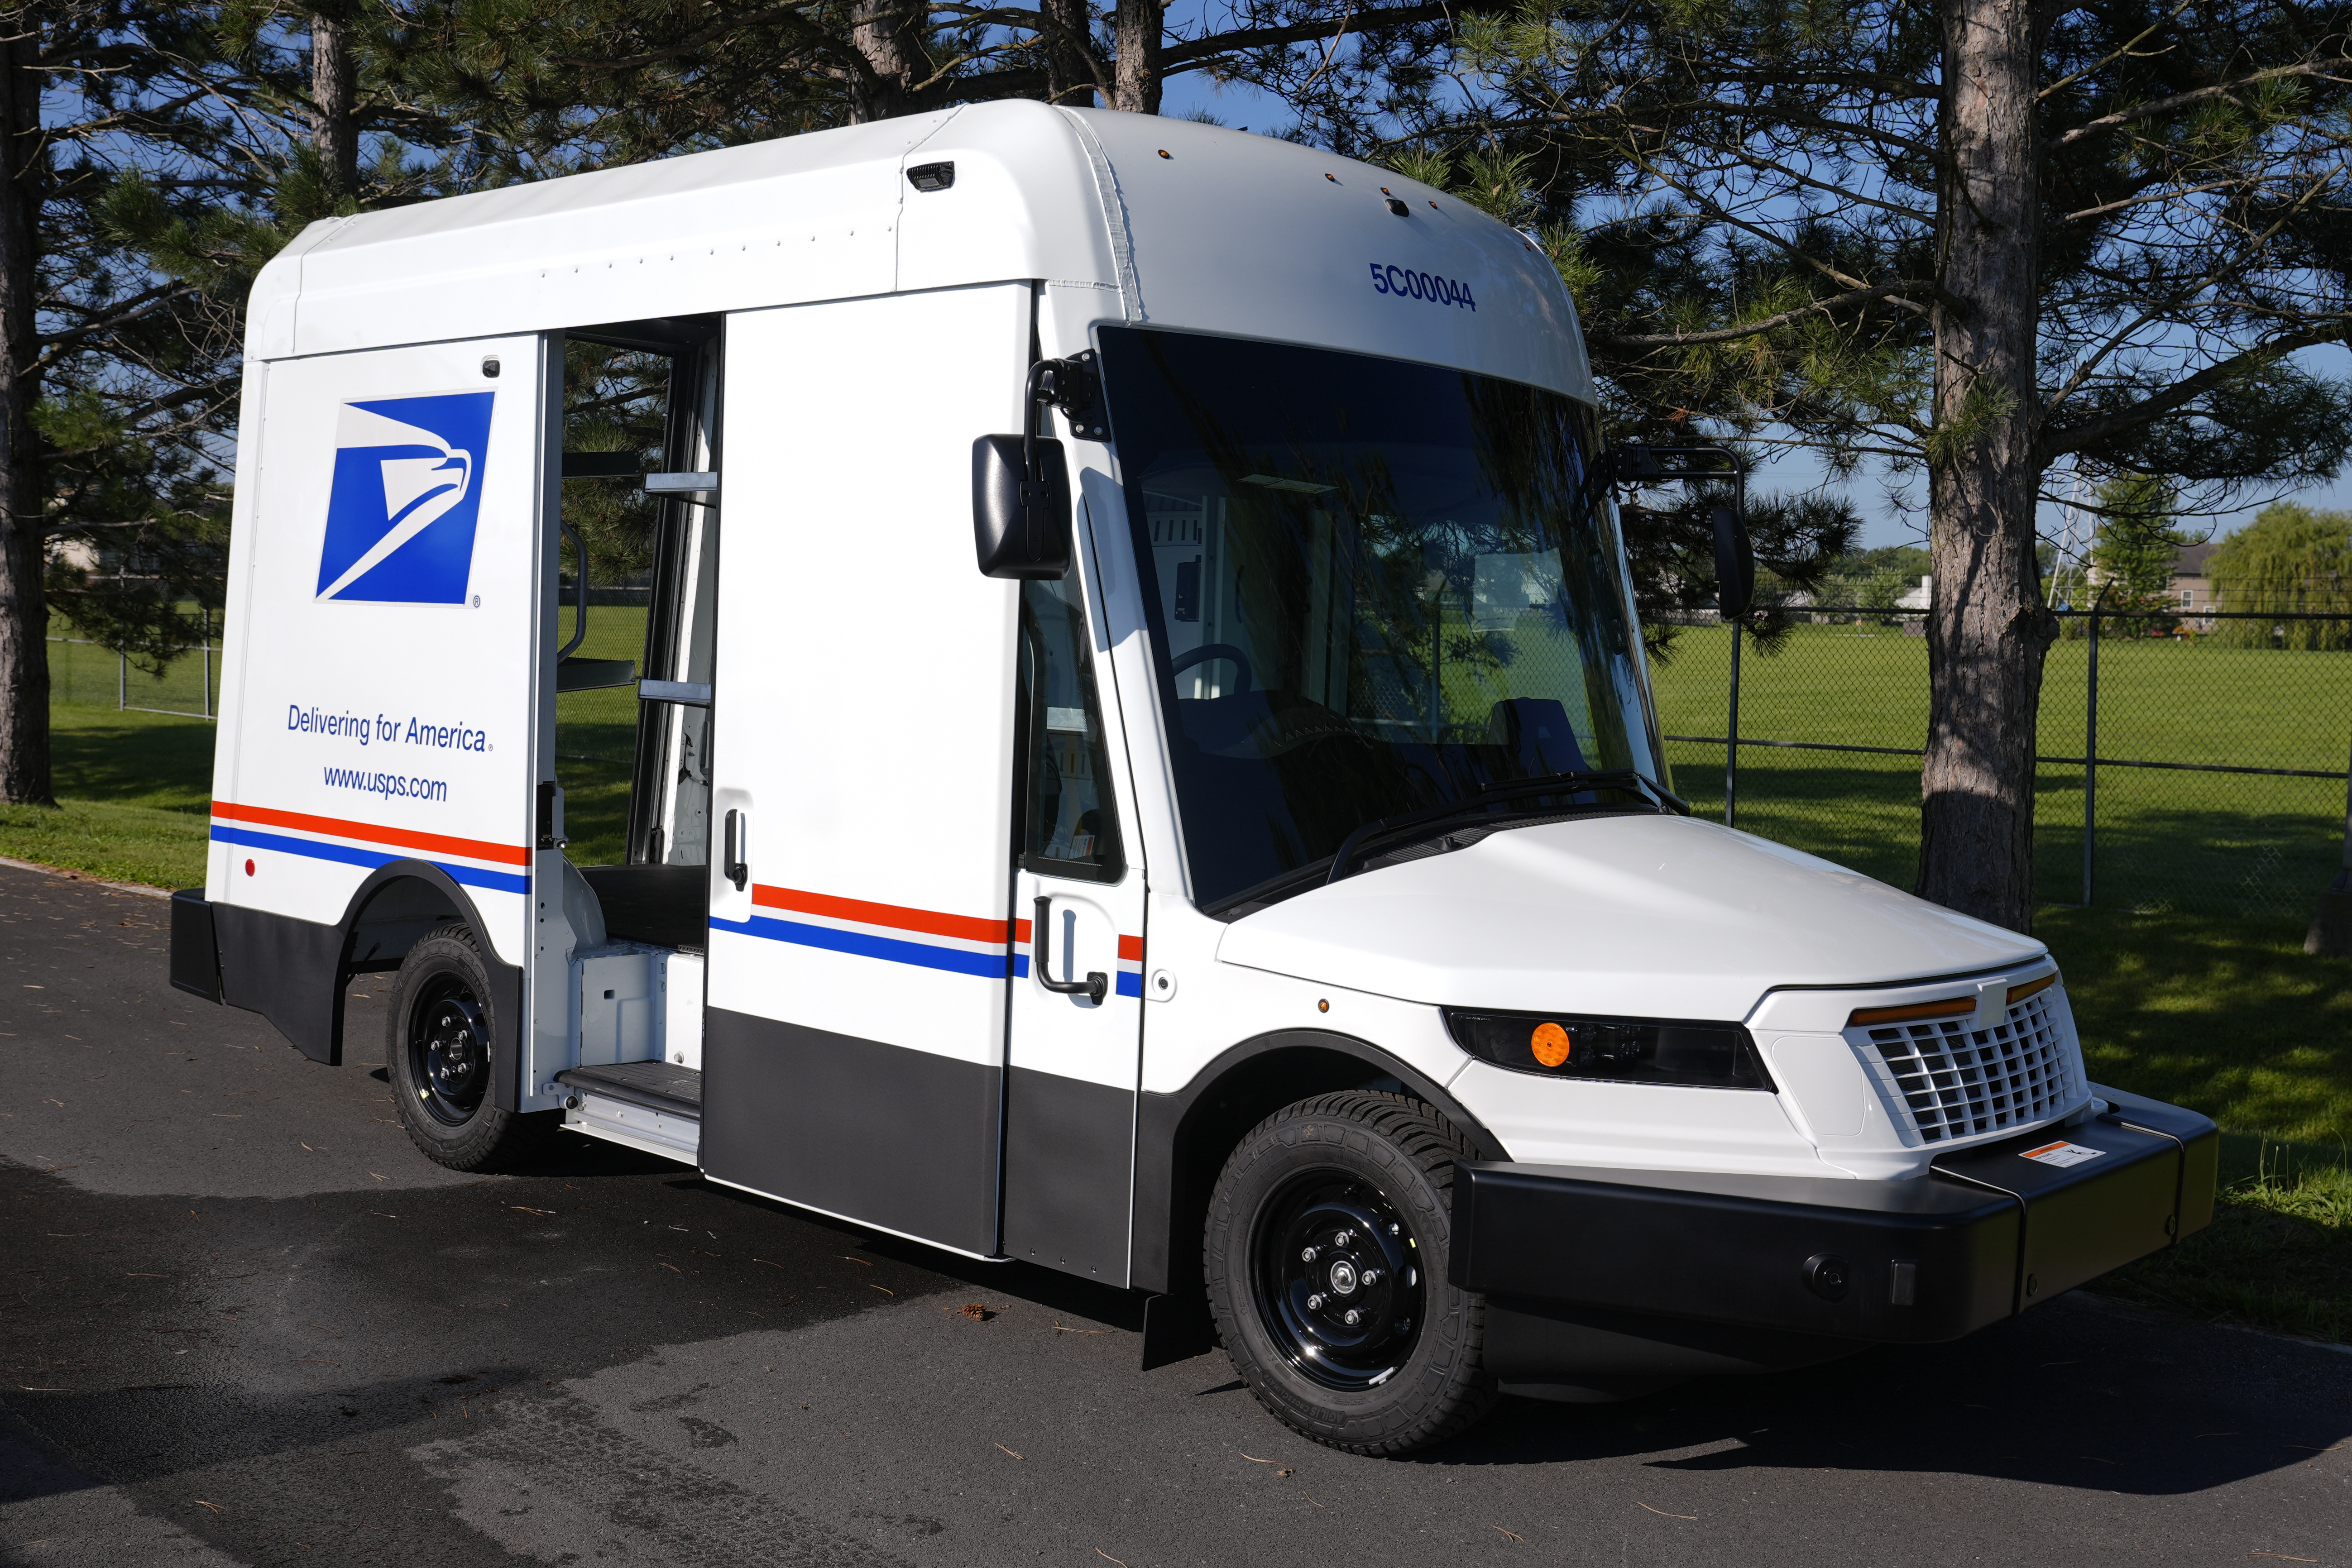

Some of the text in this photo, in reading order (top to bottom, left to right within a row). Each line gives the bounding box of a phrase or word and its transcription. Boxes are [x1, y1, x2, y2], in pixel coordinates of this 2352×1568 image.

[1370, 263, 1476, 312] 5C00044
[288, 705, 369, 746] Delivering
[376, 714, 401, 741] for
[324, 767, 447, 802] www.usps.com
[1311, 1406, 1345, 1423] AGILIS
